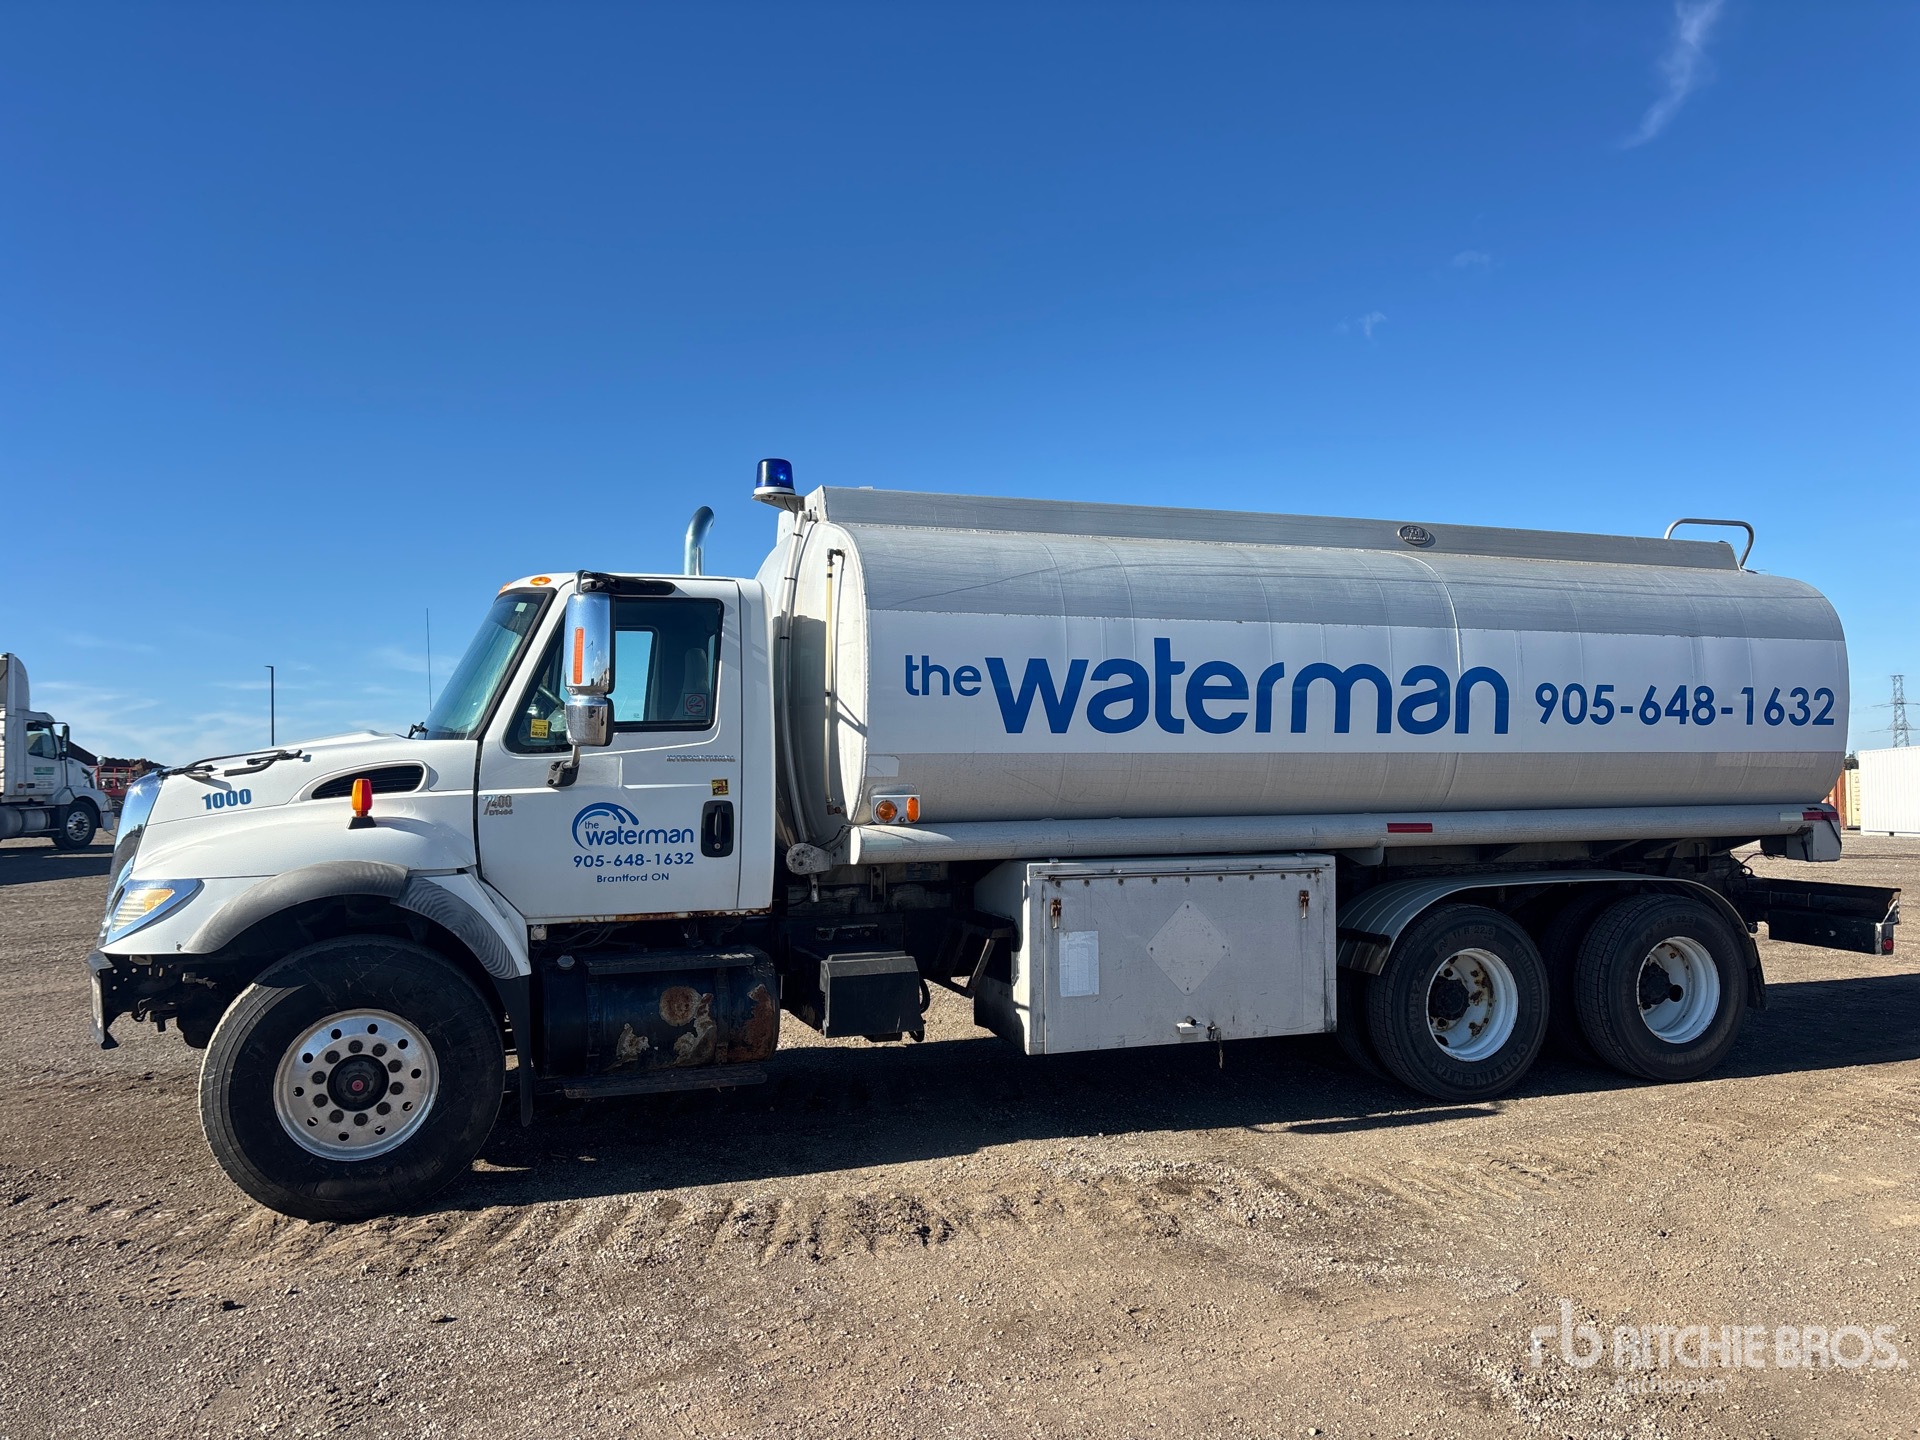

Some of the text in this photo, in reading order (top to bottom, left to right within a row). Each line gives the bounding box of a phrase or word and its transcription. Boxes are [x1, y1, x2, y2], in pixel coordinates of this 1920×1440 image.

[905, 637, 1509, 735] the waterman
[1535, 682, 1835, 726] 905-648-1632
[666, 754, 736, 763] INTERNATIONAL
[201, 788, 252, 810] 1000
[482, 795, 513, 815] 7400
[584, 821, 600, 829] the
[585, 825, 695, 846] waterman
[573, 852, 695, 868] 905-648-1632
[596, 873, 670, 883] Brantford ON
